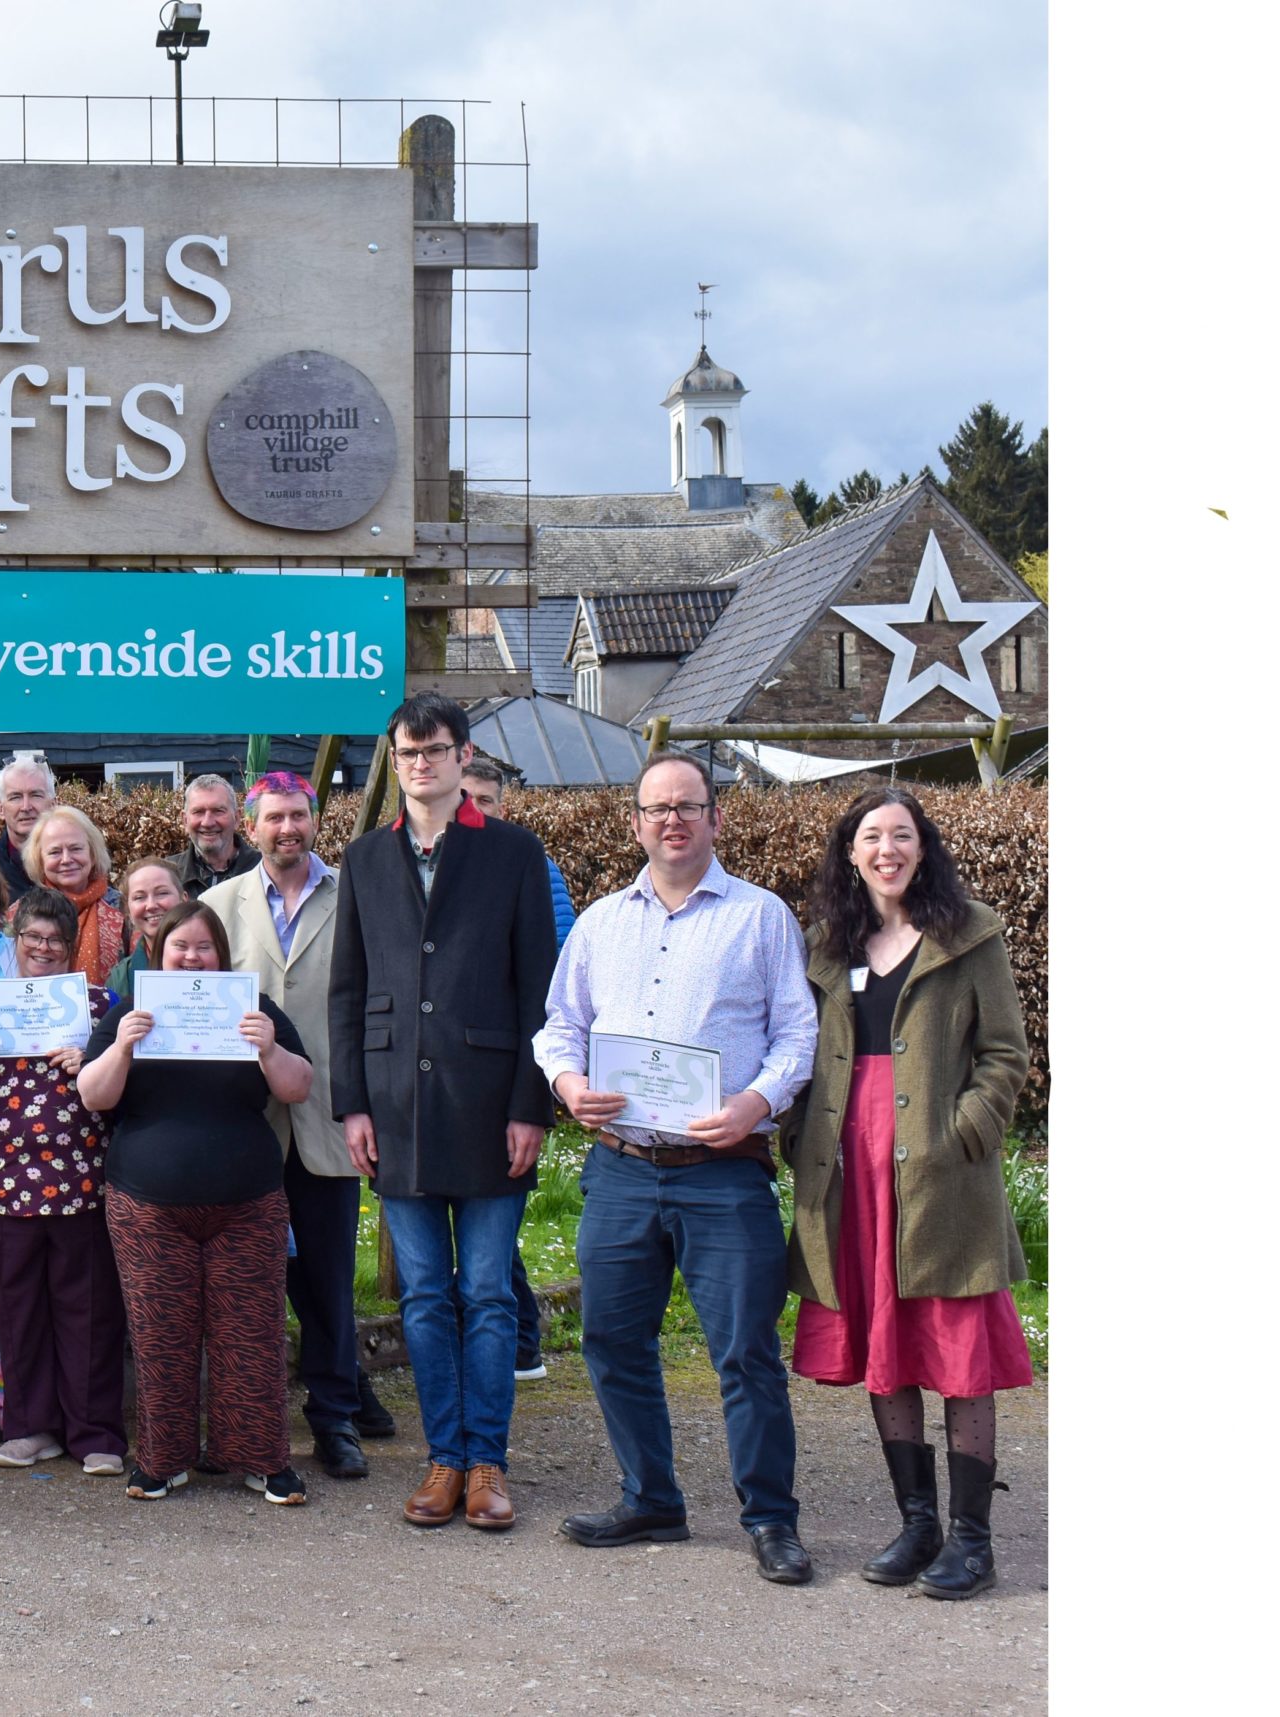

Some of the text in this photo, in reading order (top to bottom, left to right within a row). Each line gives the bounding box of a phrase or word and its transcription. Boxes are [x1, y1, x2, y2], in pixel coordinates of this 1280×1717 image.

[245, 407, 359, 435] camphill
[263, 431, 349, 460] village
[271, 455, 335, 473] trust
[265, 489, 343, 498] TAURUS CRAFTS
[247, 630, 384, 680] skills
[25, 982, 34, 994] S
[192, 979, 202, 991] S
[651, 1049, 661, 1062] S
